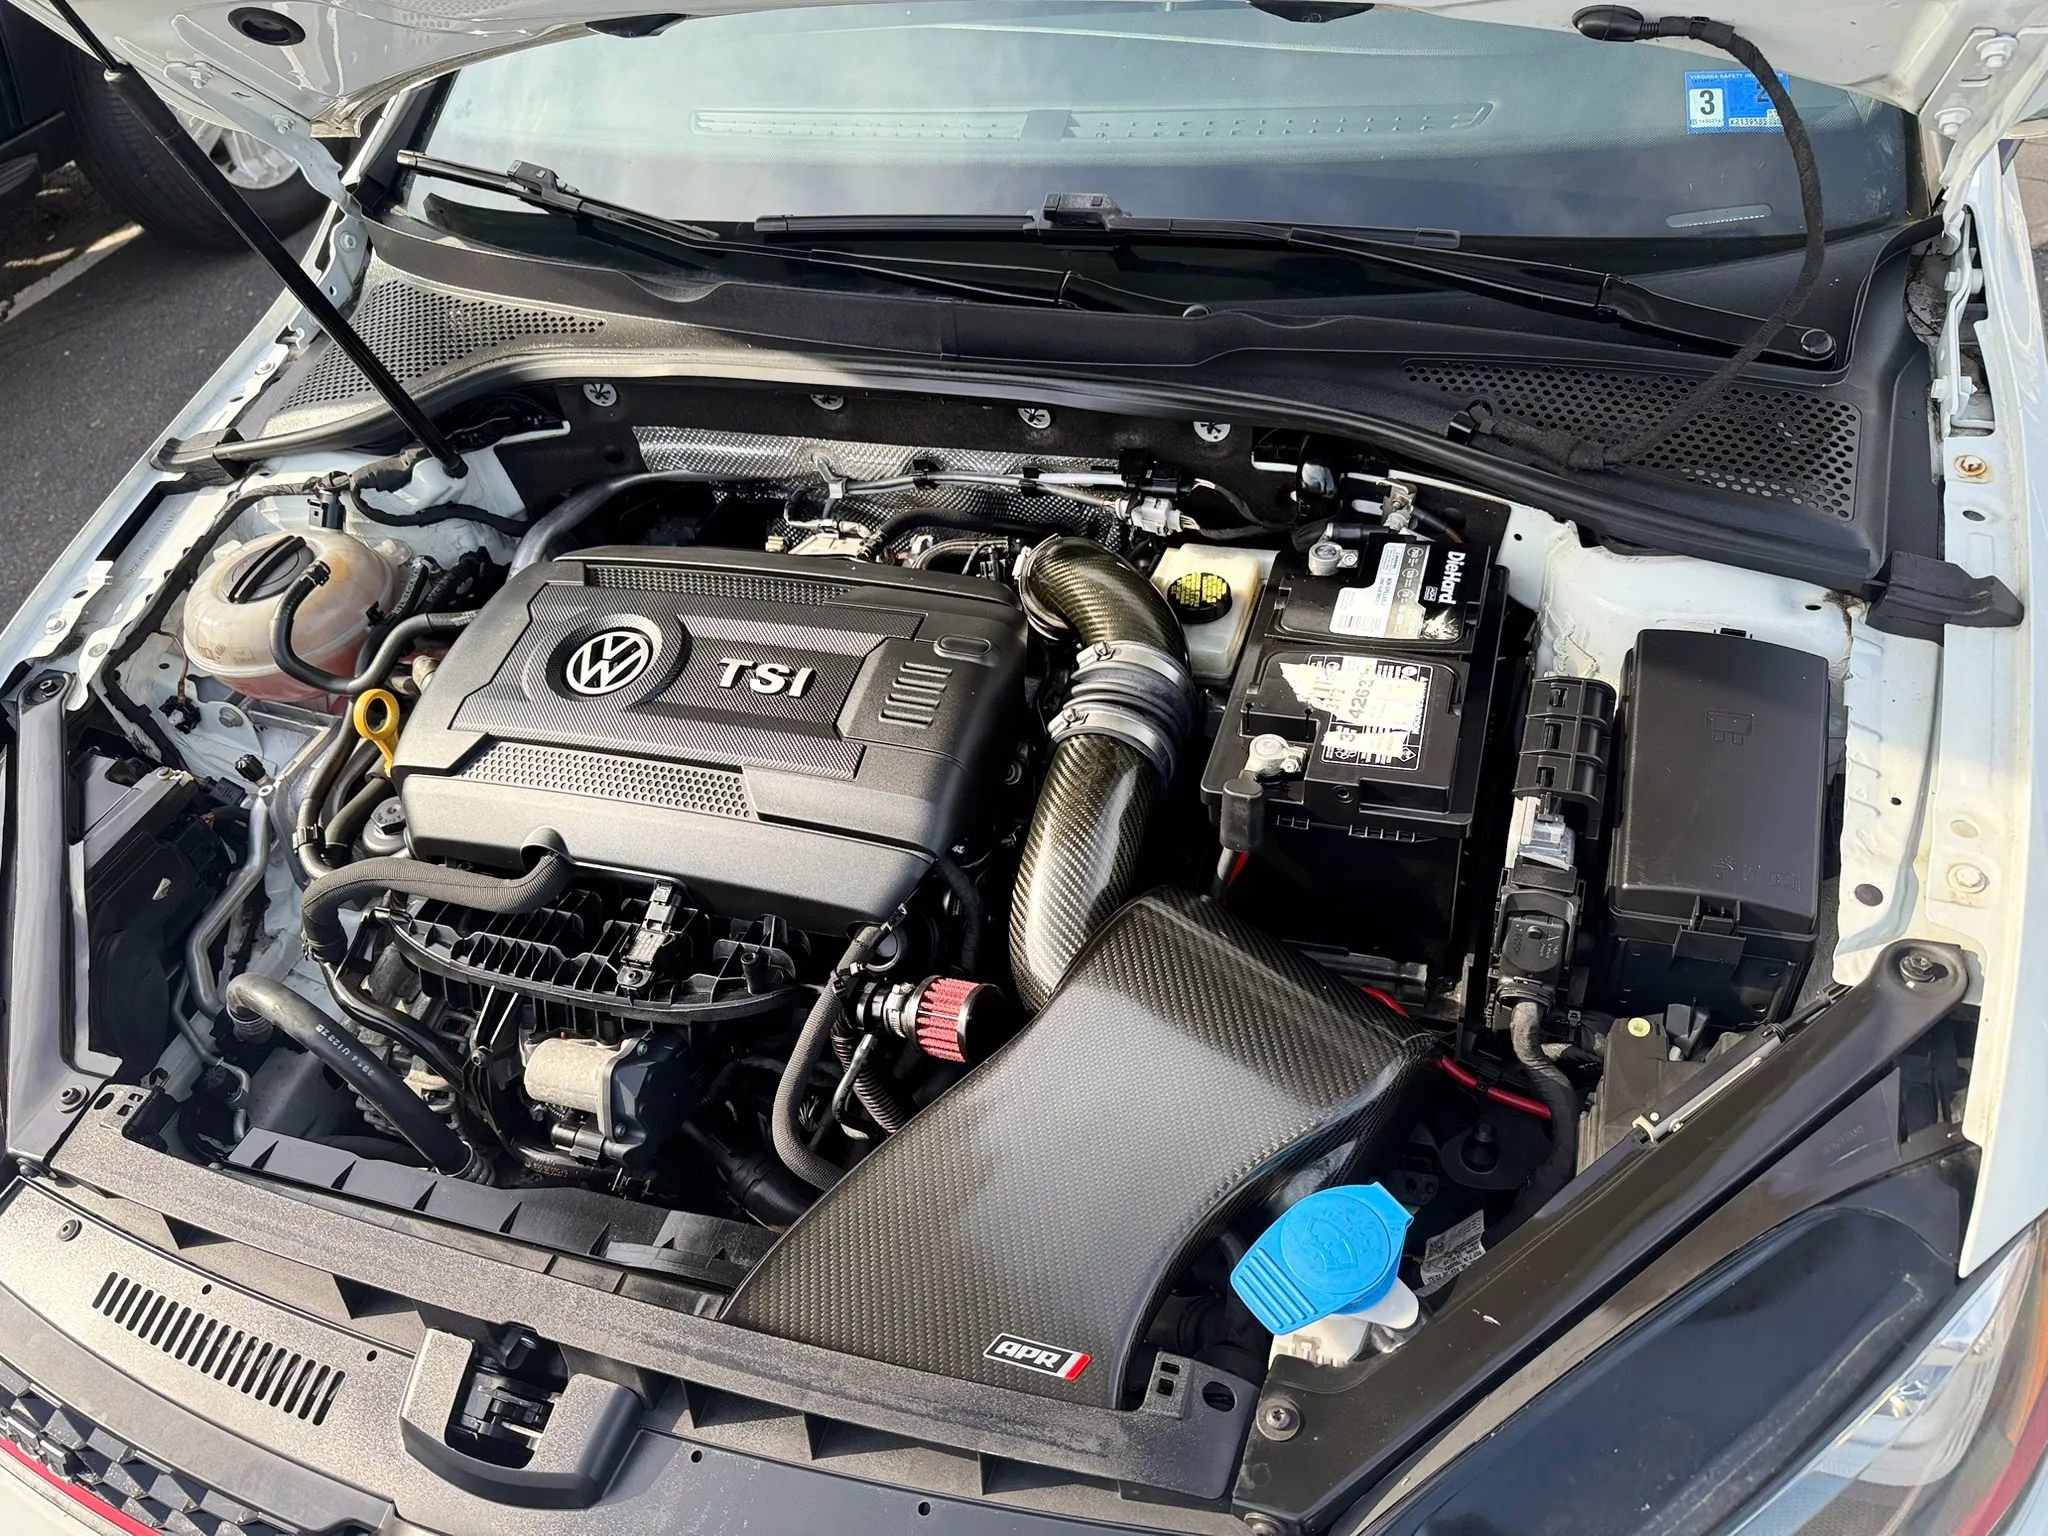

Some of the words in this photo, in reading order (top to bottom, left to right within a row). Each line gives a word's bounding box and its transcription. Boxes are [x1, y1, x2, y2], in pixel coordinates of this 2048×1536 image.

[1699, 89, 1715, 115] 3
[1438, 551, 1466, 605] DieHard
[717, 657, 814, 698] TSI
[994, 1340, 1062, 1369] APR
